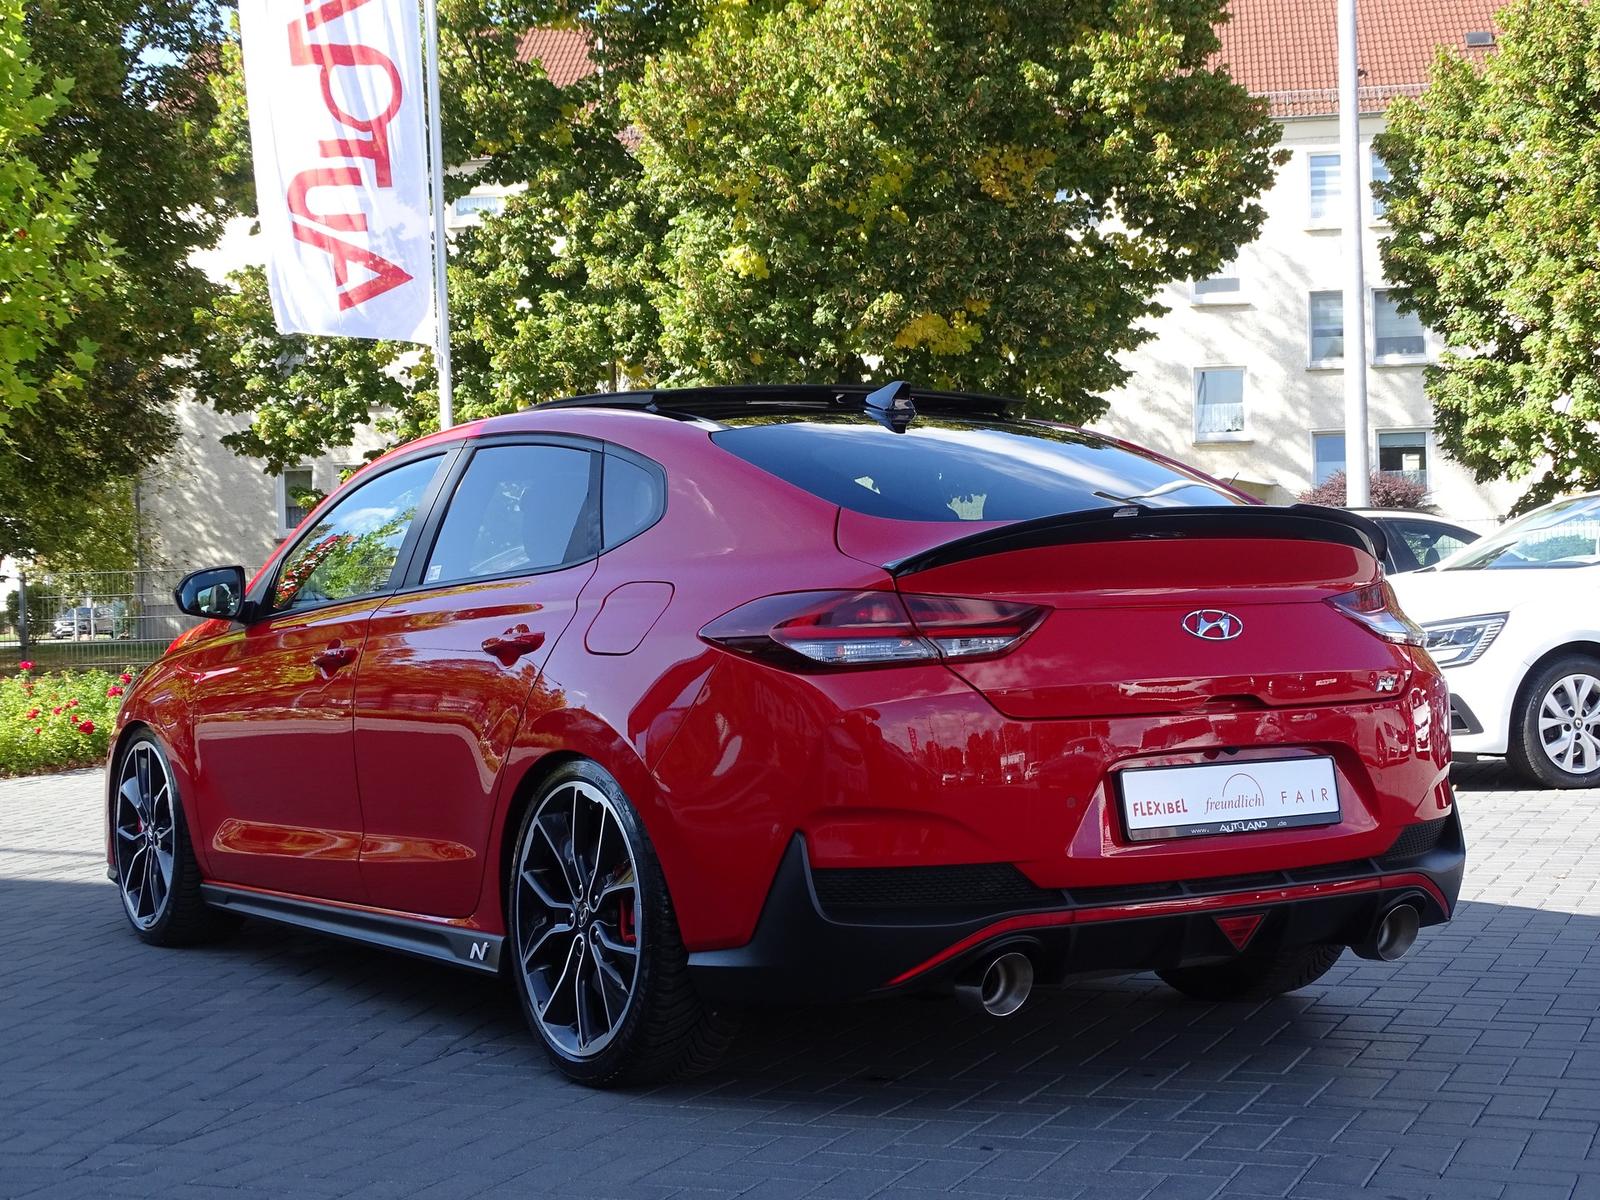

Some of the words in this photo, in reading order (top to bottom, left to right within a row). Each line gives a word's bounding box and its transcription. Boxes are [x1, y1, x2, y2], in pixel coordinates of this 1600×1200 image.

[1132, 798, 1188, 817] FLEXIBEL
[1203, 795, 1262, 815] freundlich
[1280, 787, 1329, 804] FAIR
[1219, 820, 1268, 833] AUTOLAND
